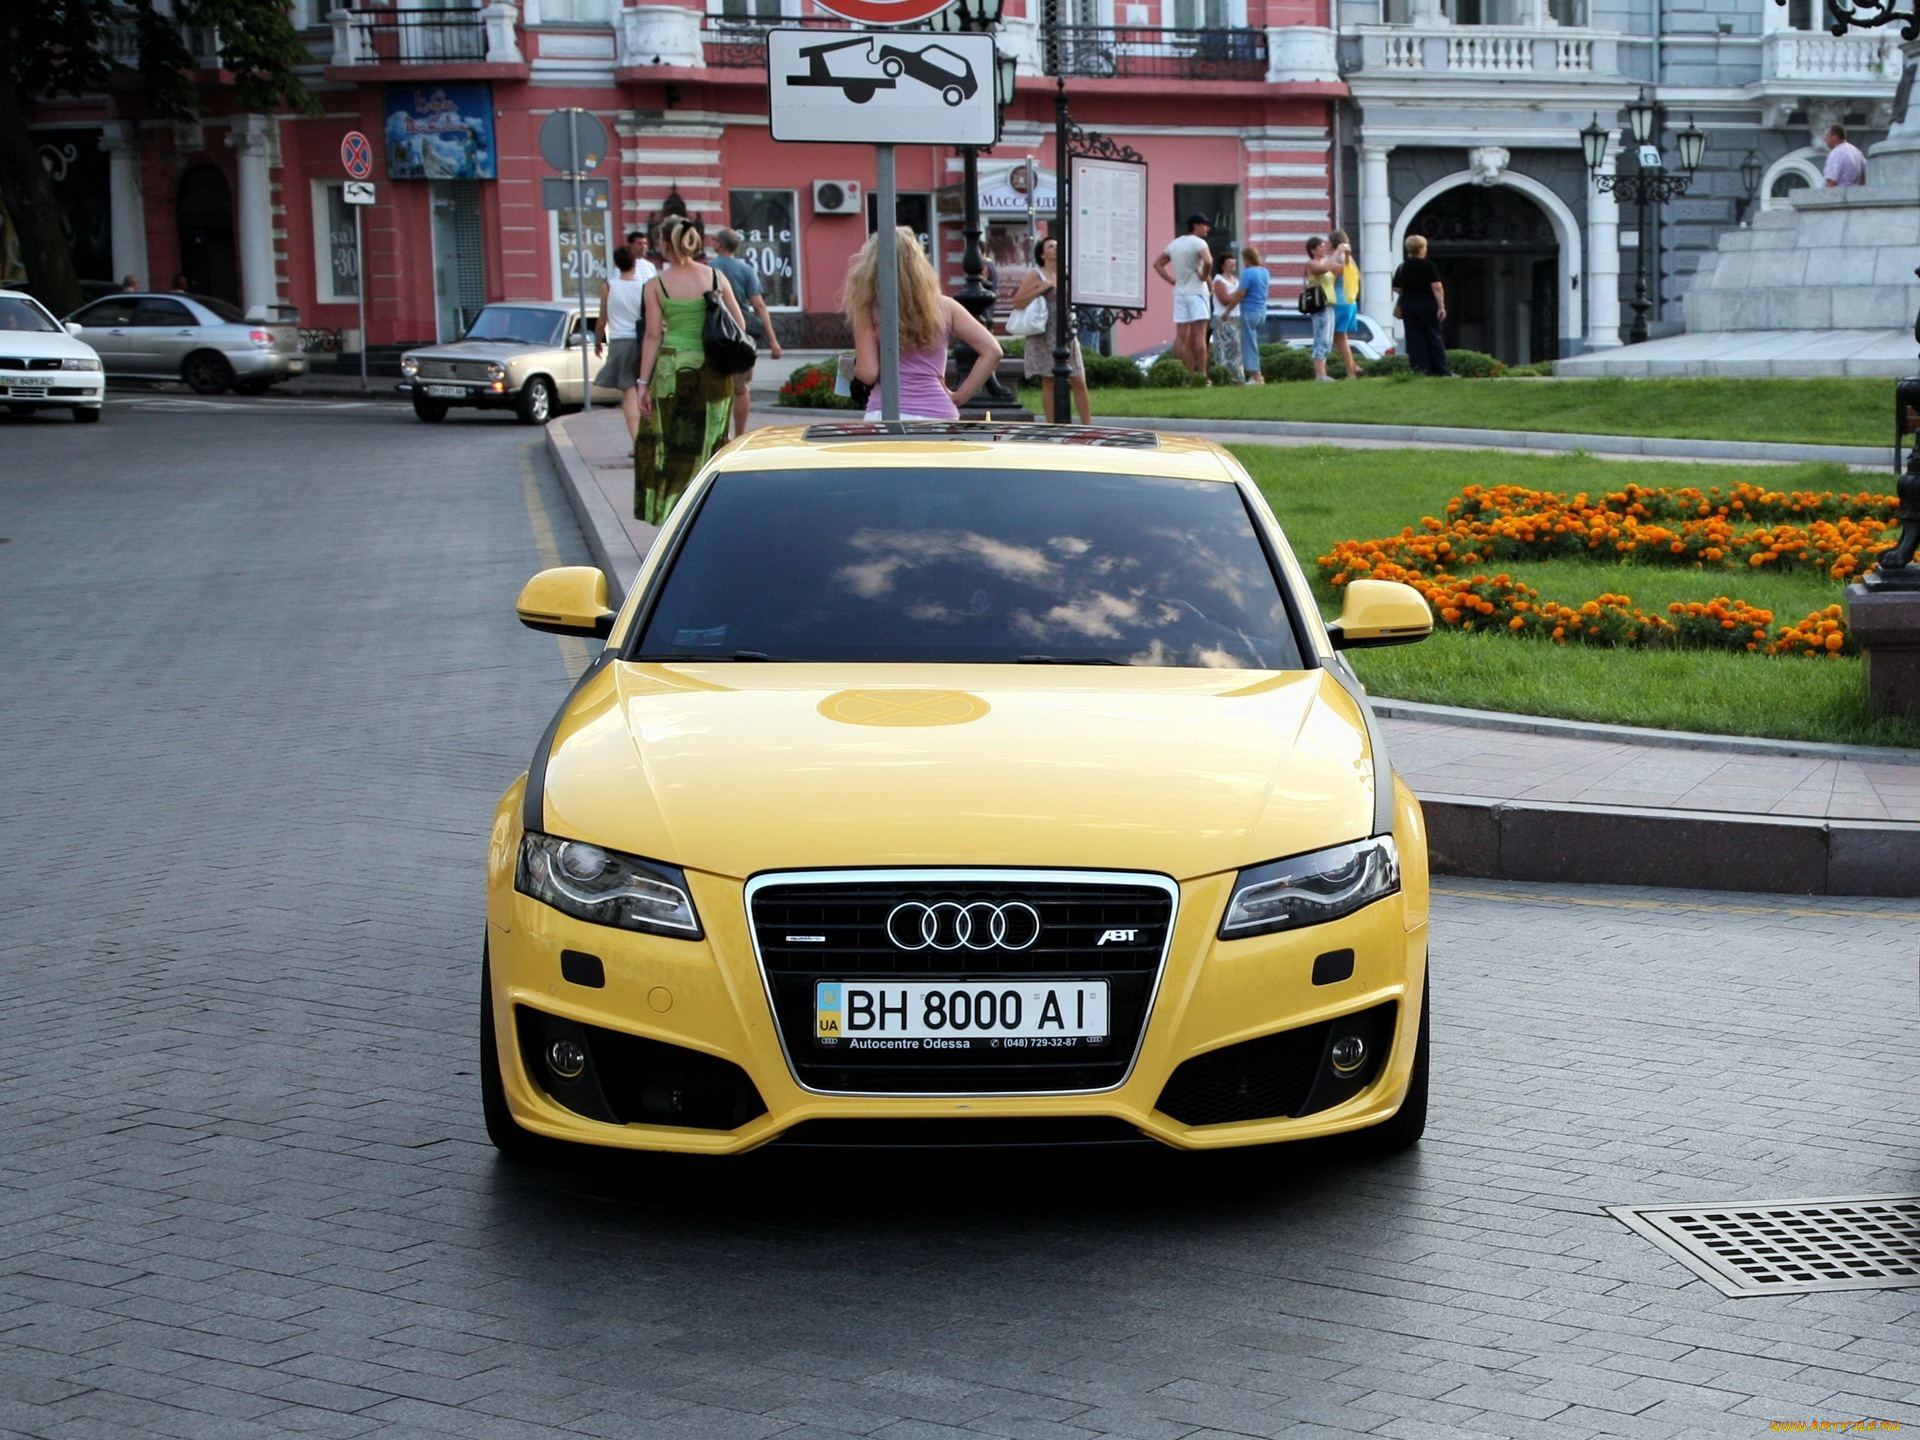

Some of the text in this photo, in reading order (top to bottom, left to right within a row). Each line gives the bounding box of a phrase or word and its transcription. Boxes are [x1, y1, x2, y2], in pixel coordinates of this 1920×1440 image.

[560, 228, 605, 245] sale
[735, 225, 791, 242] sale
[562, 249, 608, 279] -20%
[1097, 929, 1138, 946] ABT
[848, 989, 1084, 1031] BH 8000 AI
[819, 1020, 839, 1032] UA
[850, 1038, 919, 1049] Autocentre
[923, 1038, 970, 1049] Odessa
[1003, 1038, 1028, 1048] (048)
[1030, 1037, 1077, 1048] 729-32-87
